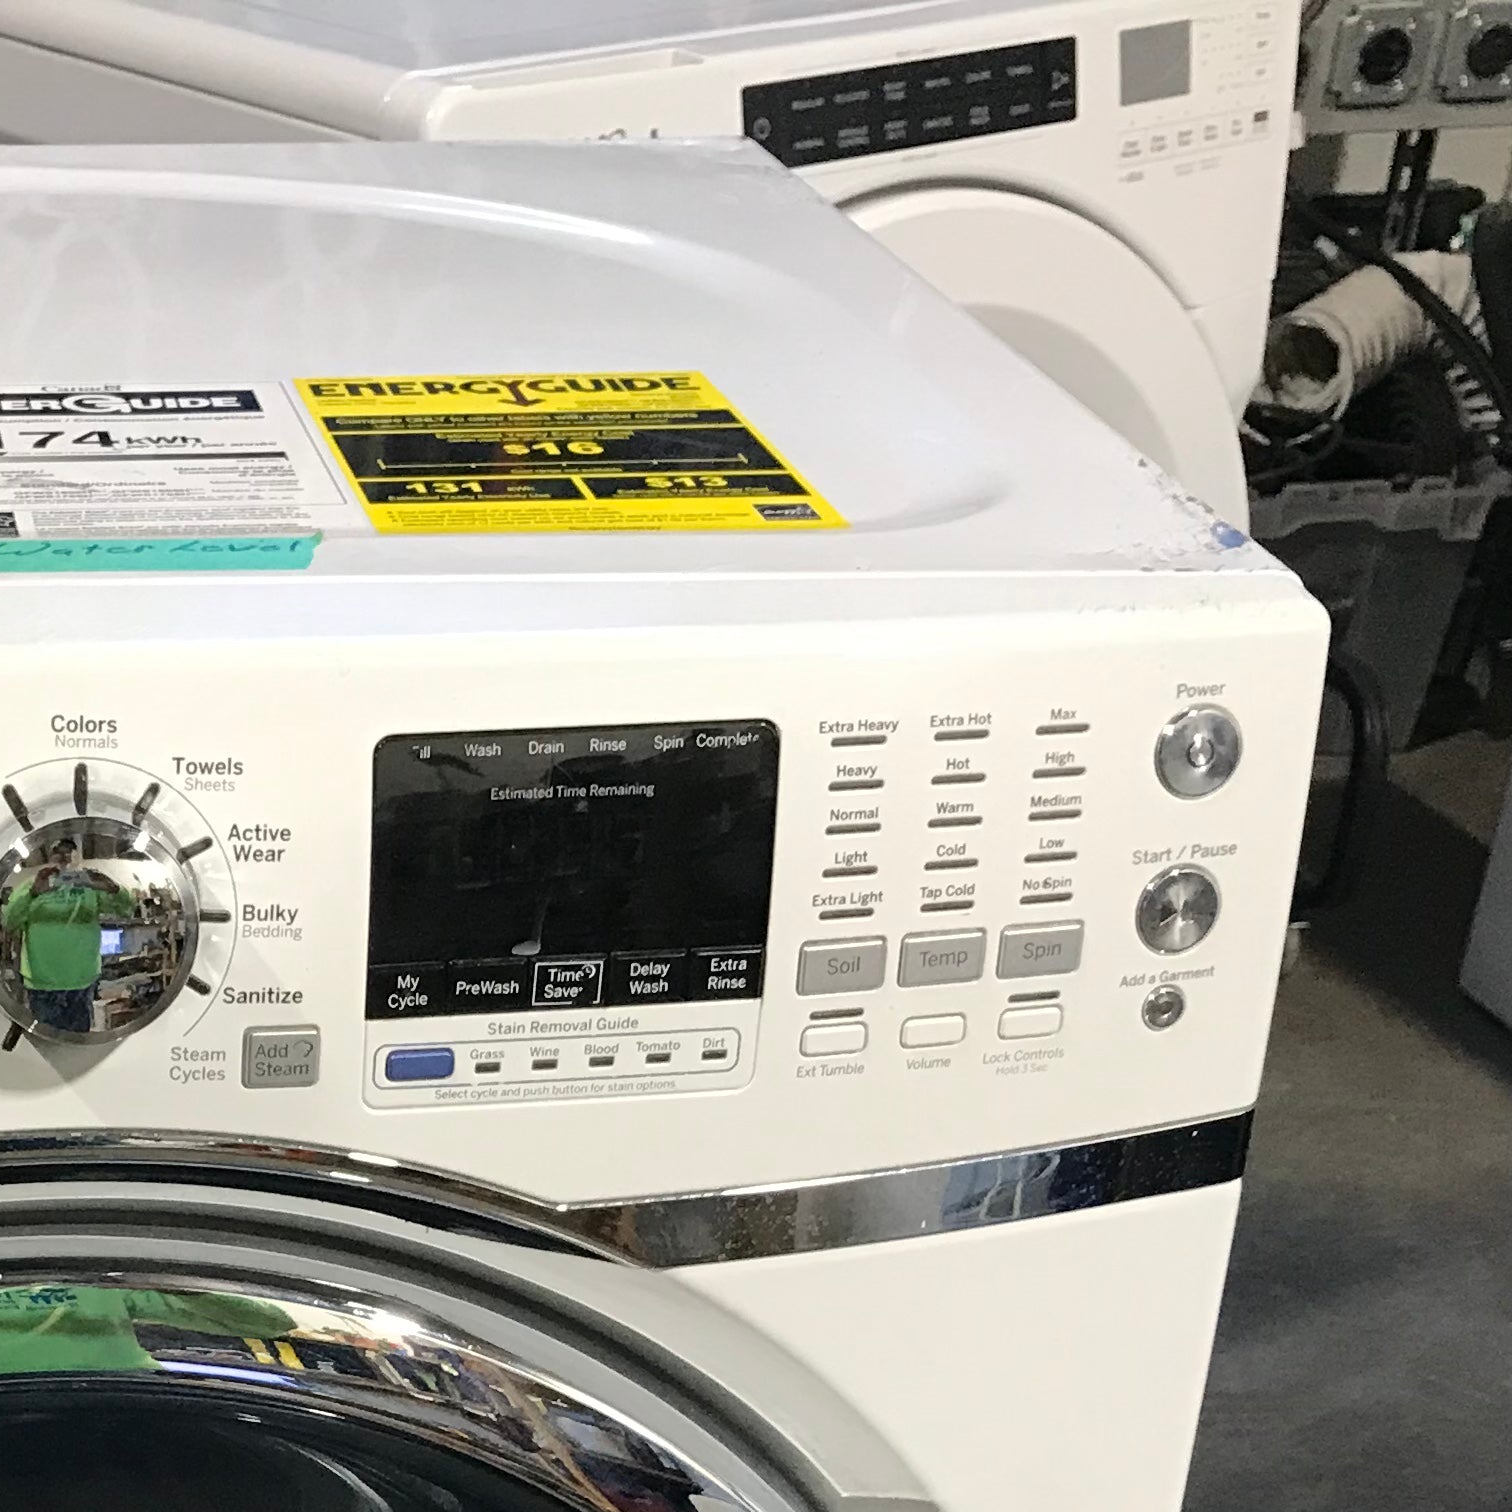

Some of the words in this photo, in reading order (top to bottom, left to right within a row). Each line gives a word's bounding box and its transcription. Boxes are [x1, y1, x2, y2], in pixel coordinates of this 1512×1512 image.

[126, 435, 202, 445] kWh
[502, 441, 605, 455] $16
[405, 481, 483, 494] 131
[1176, 682, 1225, 699] Power
[929, 714, 964, 728] Extra
[968, 712, 992, 726] Hot
[1050, 708, 1077, 721] Max
[50, 714, 118, 734] Colors
[818, 720, 854, 734] Extra
[858, 718, 899, 732] Heavy
[54, 734, 118, 749] Normals
[464, 742, 502, 758] Wash
[527, 740, 565, 755] Drain
[589, 737, 627, 752] Rinse
[653, 734, 684, 752] Spin
[172, 756, 244, 775] Towels
[946, 758, 970, 771] Hot
[1044, 751, 1076, 767] High
[835, 764, 878, 779] Heavy
[183, 776, 236, 792] Sheets
[490, 785, 554, 800] Estimated
[556, 784, 587, 798] Time
[589, 783, 655, 798] Remaining
[936, 801, 974, 814] Warm
[1029, 794, 1083, 808] Medium
[829, 806, 880, 821] Normal
[226, 823, 292, 842] Active
[936, 843, 967, 858] Cold
[1038, 836, 1065, 850] Low
[232, 844, 286, 862] Wear
[834, 851, 868, 867] Light
[1131, 848, 1172, 866] Start
[1189, 842, 1238, 860] Pause
[919, 886, 943, 901] Tap
[945, 883, 976, 898] Cold
[1022, 878, 1040, 891] No
[1044, 876, 1073, 892] Spin
[812, 894, 847, 908] Extra
[849, 891, 884, 907] Light
[242, 904, 299, 926] Bulky
[241, 924, 303, 942] Bedding
[919, 950, 969, 970] Temp
[1021, 942, 1063, 962] Spin
[629, 961, 671, 978] Delay
[710, 956, 748, 972] Extra
[826, 956, 861, 976] Soil
[397, 973, 420, 992] My
[548, 967, 584, 983] Time
[707, 975, 747, 991] Rinse
[1119, 973, 1146, 988] Add
[1148, 975, 1157, 985] a
[1158, 966, 1216, 984] Garment
[455, 980, 520, 996] PreWash
[629, 978, 669, 995] Wash
[222, 986, 304, 1005] Sanitize
[387, 992, 428, 1011] Cycle
[487, 1021, 526, 1036] Stain
[529, 1018, 592, 1034] Removal
[596, 1015, 639, 1032] Guide
[254, 1043, 289, 1059] Add
[584, 1042, 620, 1055] Blood
[635, 1040, 681, 1052] Tomato
[702, 1037, 726, 1049] Dirt
[170, 1046, 227, 1063] Steam
[469, 1048, 505, 1061] Grass
[529, 1046, 560, 1058] Wine
[982, 1051, 1011, 1065] Lock
[1013, 1047, 1065, 1062] Controls
[254, 1061, 310, 1078] Steam
[795, 1065, 816, 1079] Ext
[821, 1062, 865, 1078] Tumble
[906, 1056, 952, 1071] Volume
[168, 1065, 226, 1085] Cycles
[434, 1088, 469, 1101] Select
[470, 1087, 498, 1100] cycle
[500, 1086, 521, 1097] and
[523, 1085, 550, 1098] push
[551, 1083, 590, 1096] button
[590, 1081, 605, 1093] for
[607, 1080, 635, 1093] stain
